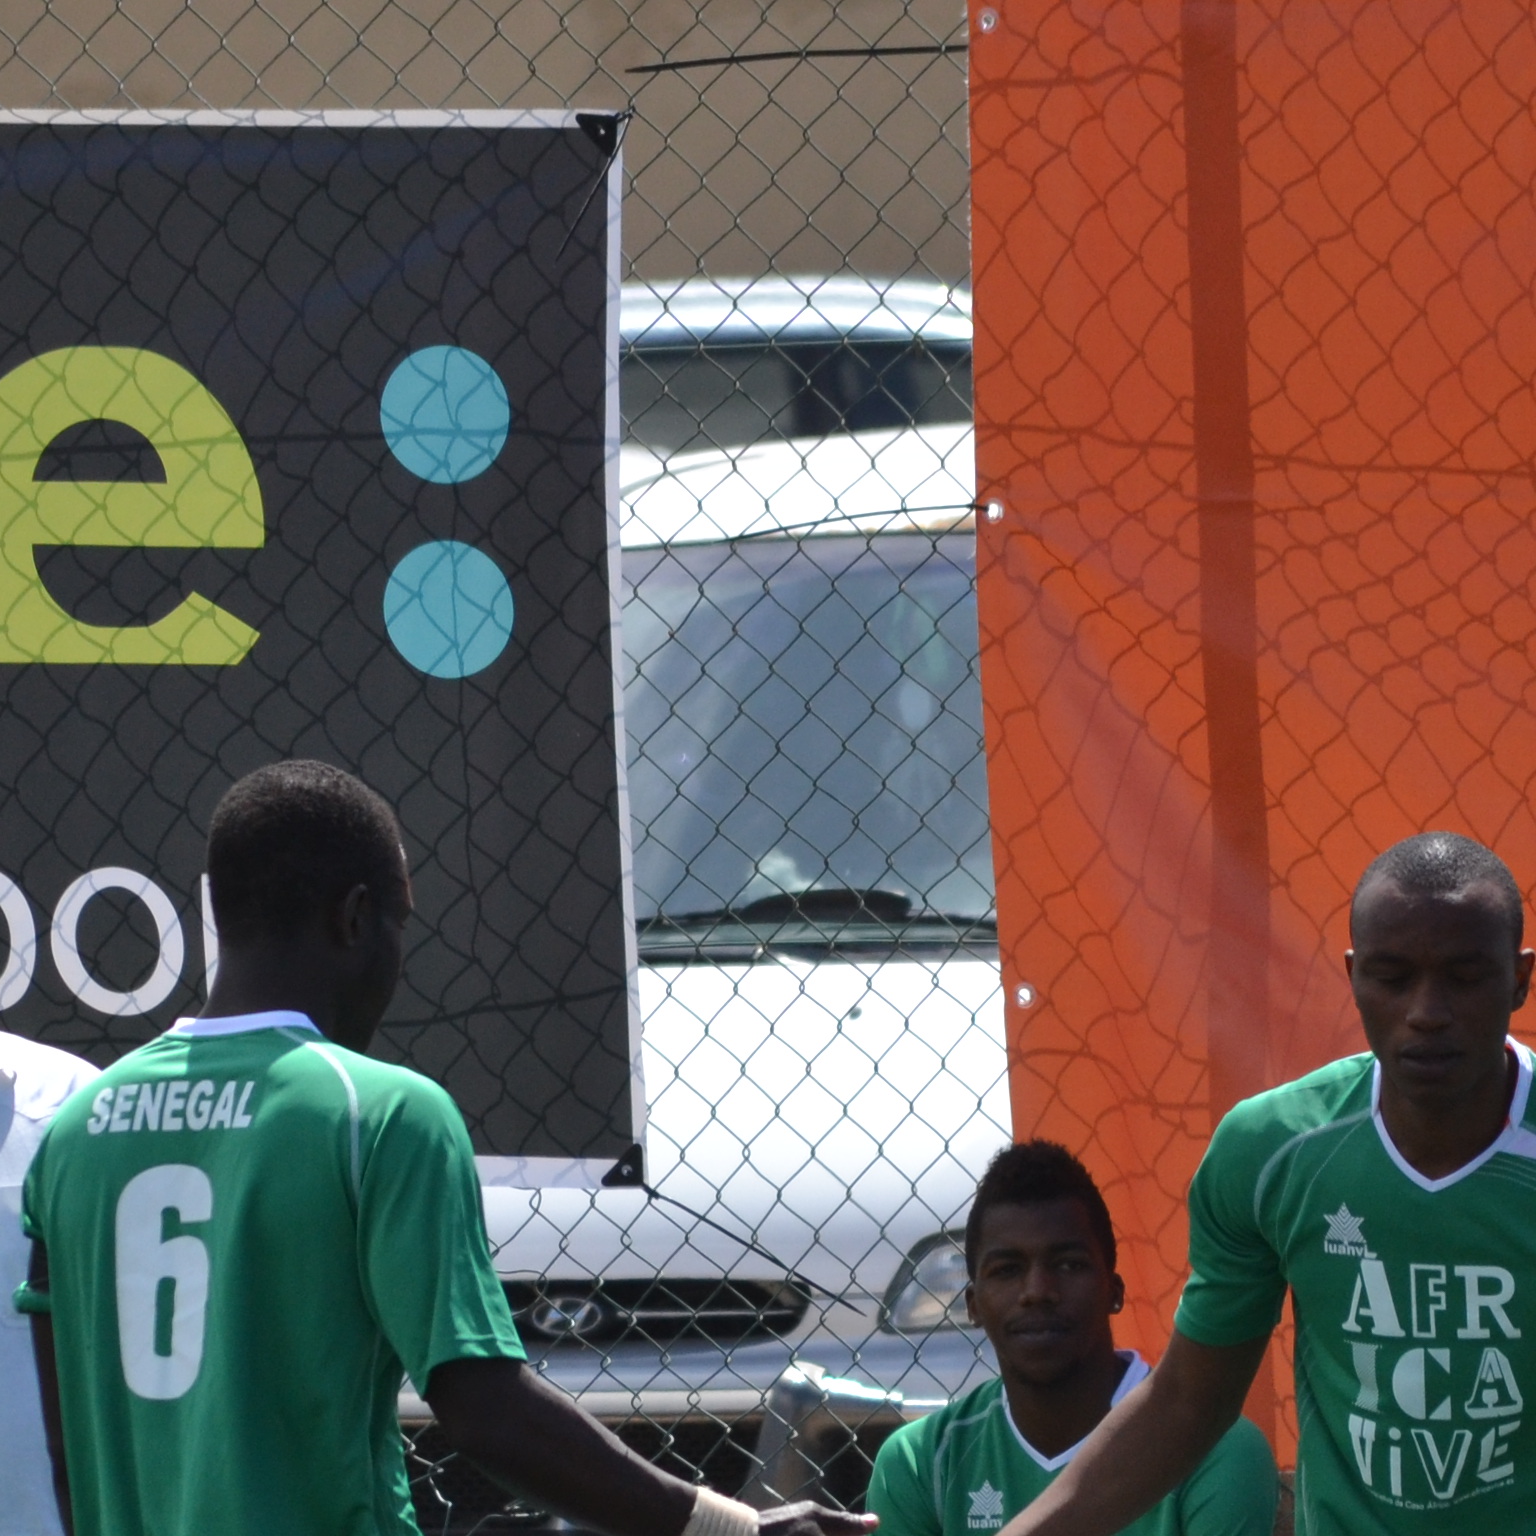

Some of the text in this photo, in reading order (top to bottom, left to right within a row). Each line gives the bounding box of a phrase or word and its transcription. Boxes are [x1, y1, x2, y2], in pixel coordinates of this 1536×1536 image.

[87, 1079, 255, 1135] SENEGAL
[115, 1163, 212, 1400] 6
[1343, 1340, 1524, 1421] ICA
